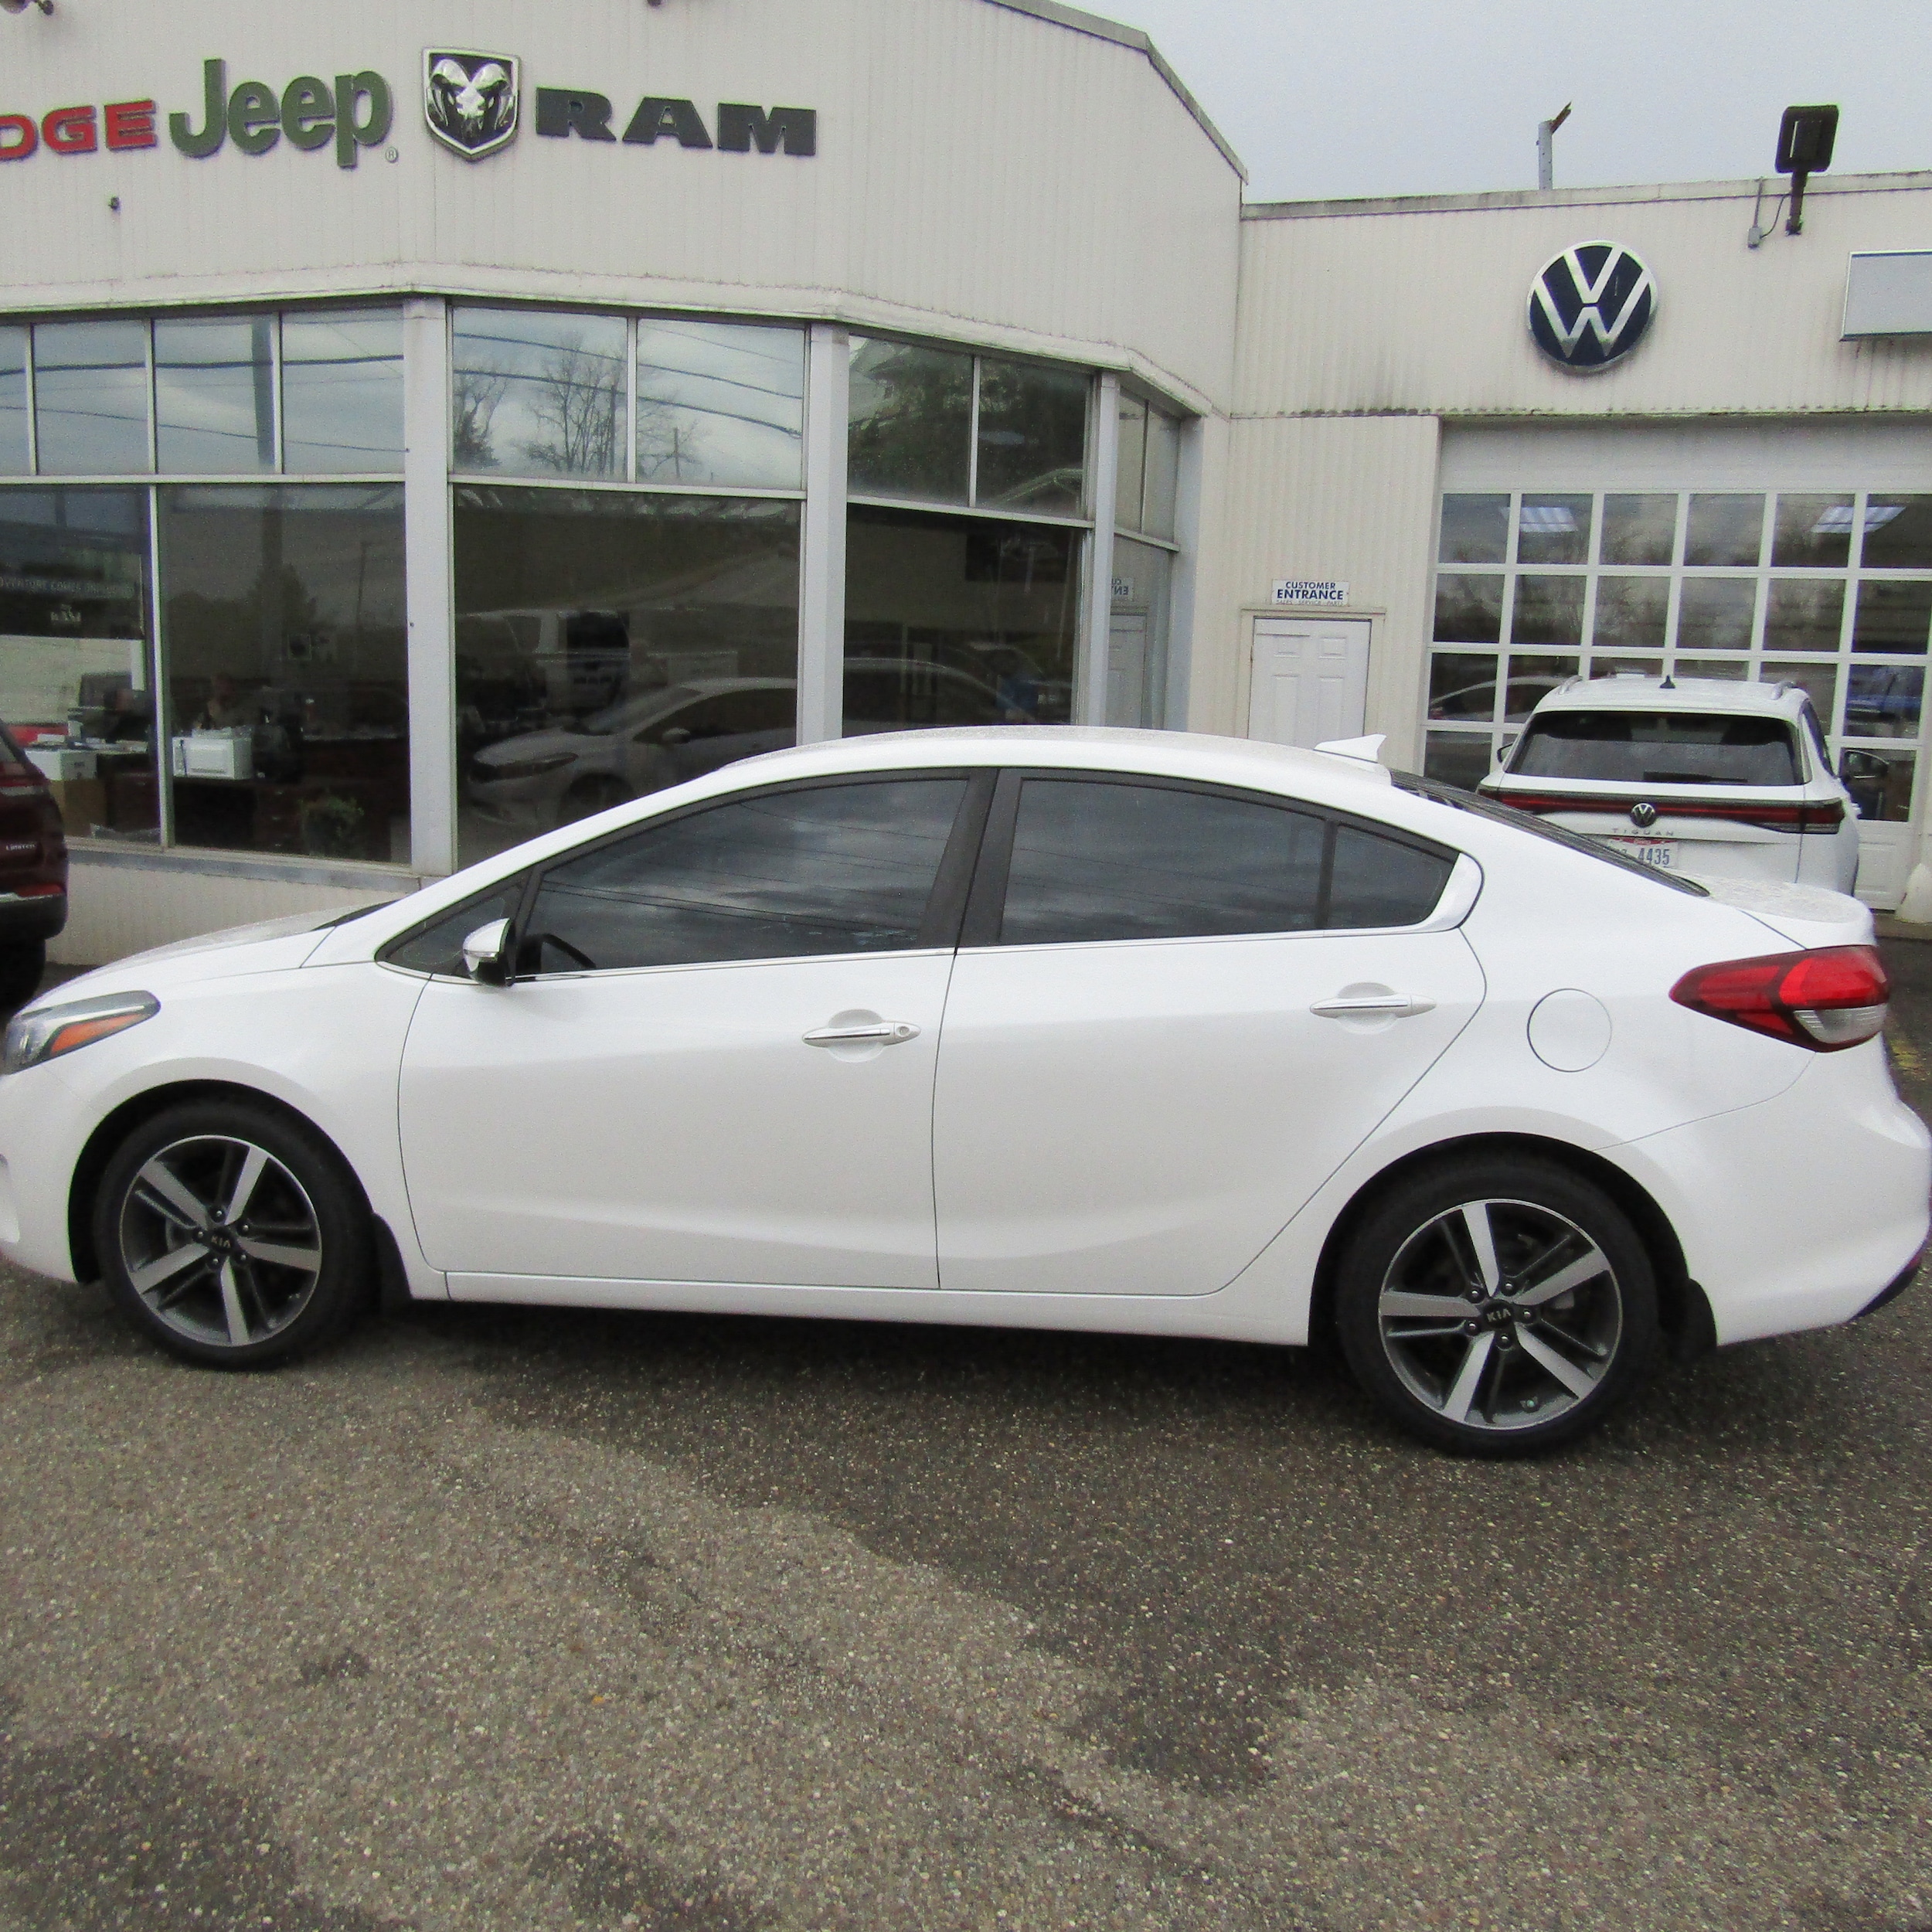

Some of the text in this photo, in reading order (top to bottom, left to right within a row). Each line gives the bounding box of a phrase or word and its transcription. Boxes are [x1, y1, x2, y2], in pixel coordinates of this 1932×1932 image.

[169, 58, 394, 169] Jeep
[536, 86, 817, 156] RAM
[1277, 590, 1344, 600] ENTRANCE
[1285, 581, 1336, 590] CUSTOMER
